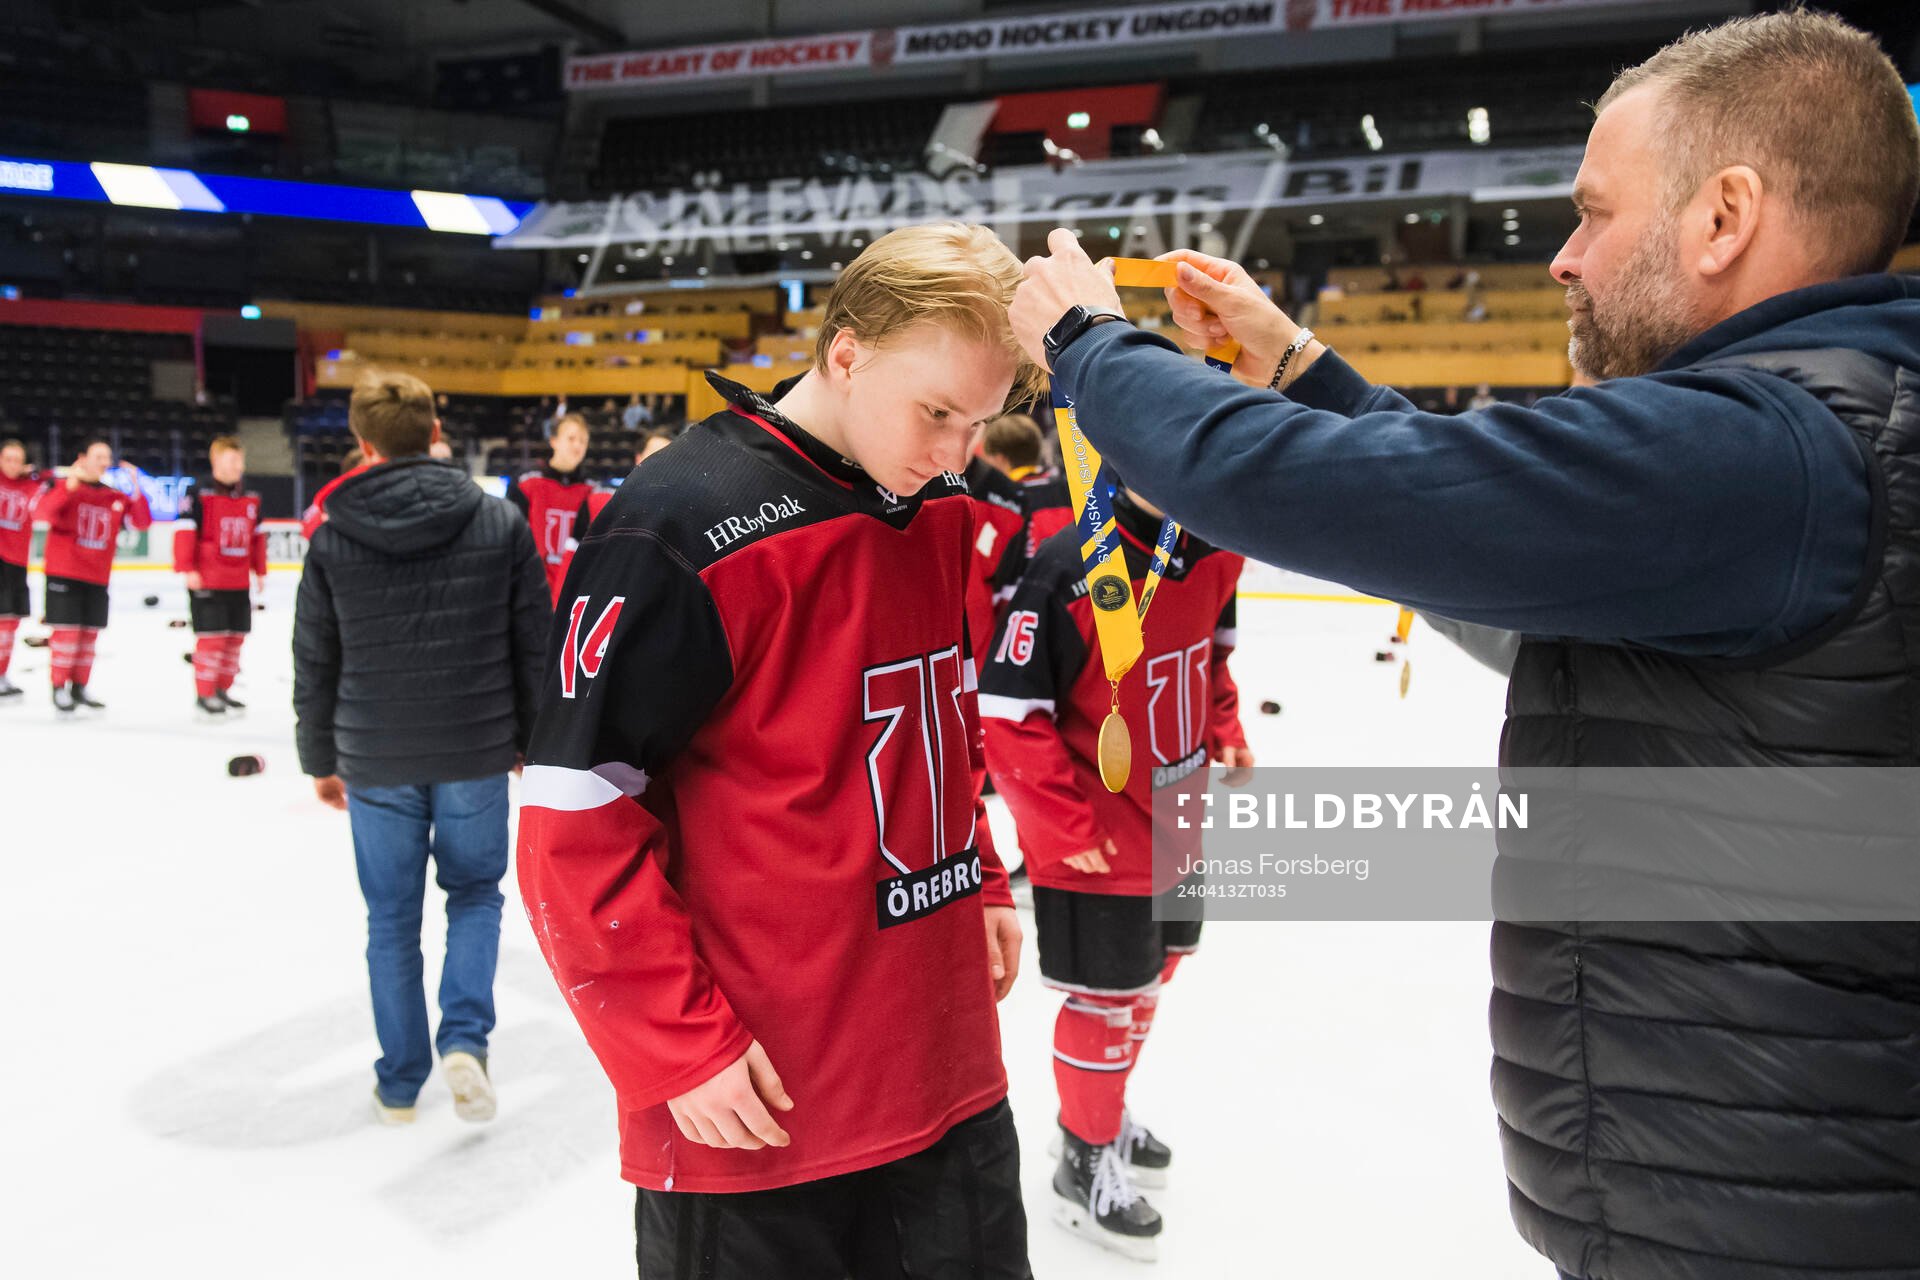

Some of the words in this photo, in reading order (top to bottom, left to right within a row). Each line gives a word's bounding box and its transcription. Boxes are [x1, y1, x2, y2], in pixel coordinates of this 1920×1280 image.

[905, 29, 994, 55] MODO
[1000, 19, 1124, 46] HOCKEY
[1130, 2, 1274, 36] UNGDOM
[570, 63, 613, 81] THE
[621, 53, 706, 78] HEART
[710, 50, 743, 71] OF
[750, 41, 860, 67] HOCKEY
[703, 495, 807, 552] HRbyOak
[1084, 487, 1112, 563] SVENSKA
[560, 595, 626, 698] 14
[994, 610, 1039, 666] 16
[887, 856, 982, 917] ÖREBRO
